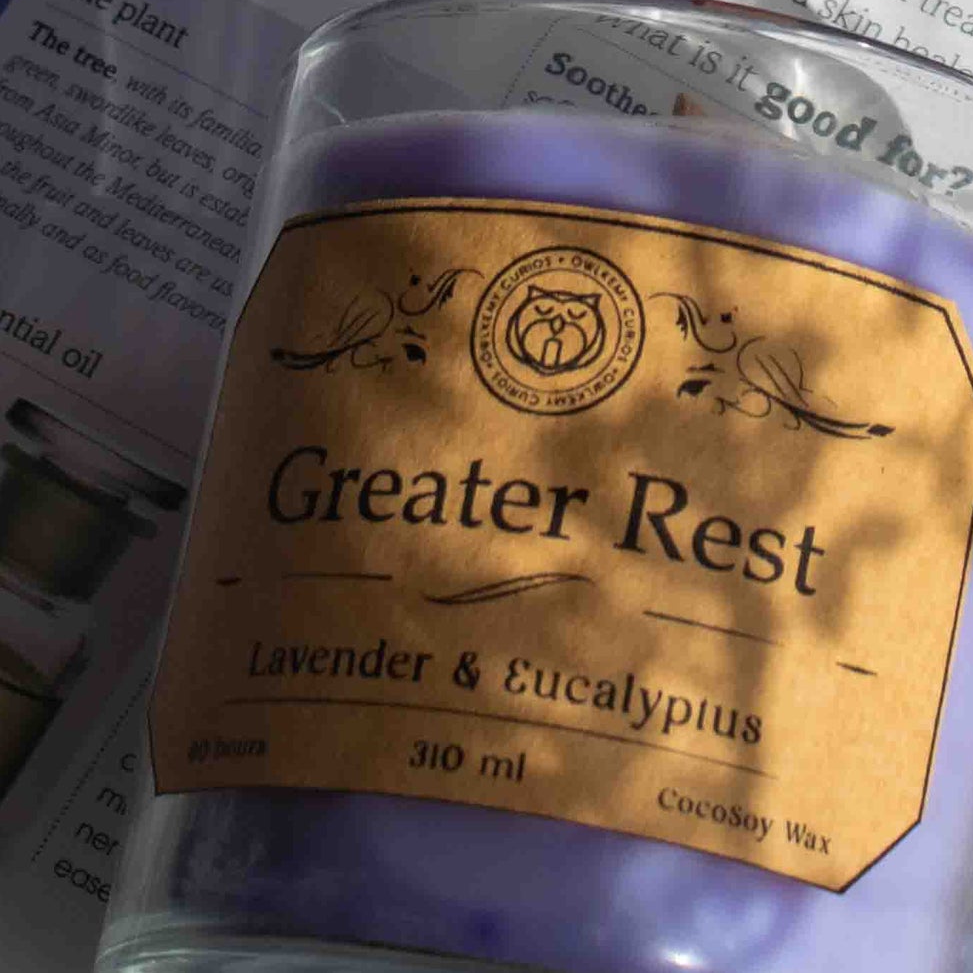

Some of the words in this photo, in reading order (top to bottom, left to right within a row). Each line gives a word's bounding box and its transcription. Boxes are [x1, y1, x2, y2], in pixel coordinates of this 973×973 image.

[111, 2, 189, 49] plant
[28, 20, 71, 56] The
[125, 75, 169, 106] with
[754, 80, 878, 151] good
[75, 201, 120, 230] and
[114, 218, 176, 263] leaves
[61, 347, 104, 379] oil
[267, 443, 589, 541] Greater
[614, 470, 825, 597] Rest
[248, 639, 434, 683] Lavender
[453, 652, 481, 690] &
[504, 657, 764, 745] Eucalyptus
[408, 739, 465, 773] 310
[480, 746, 525, 784] ml
[657, 787, 774, 843] CocoSoy
[784, 822, 833, 856] Wax
